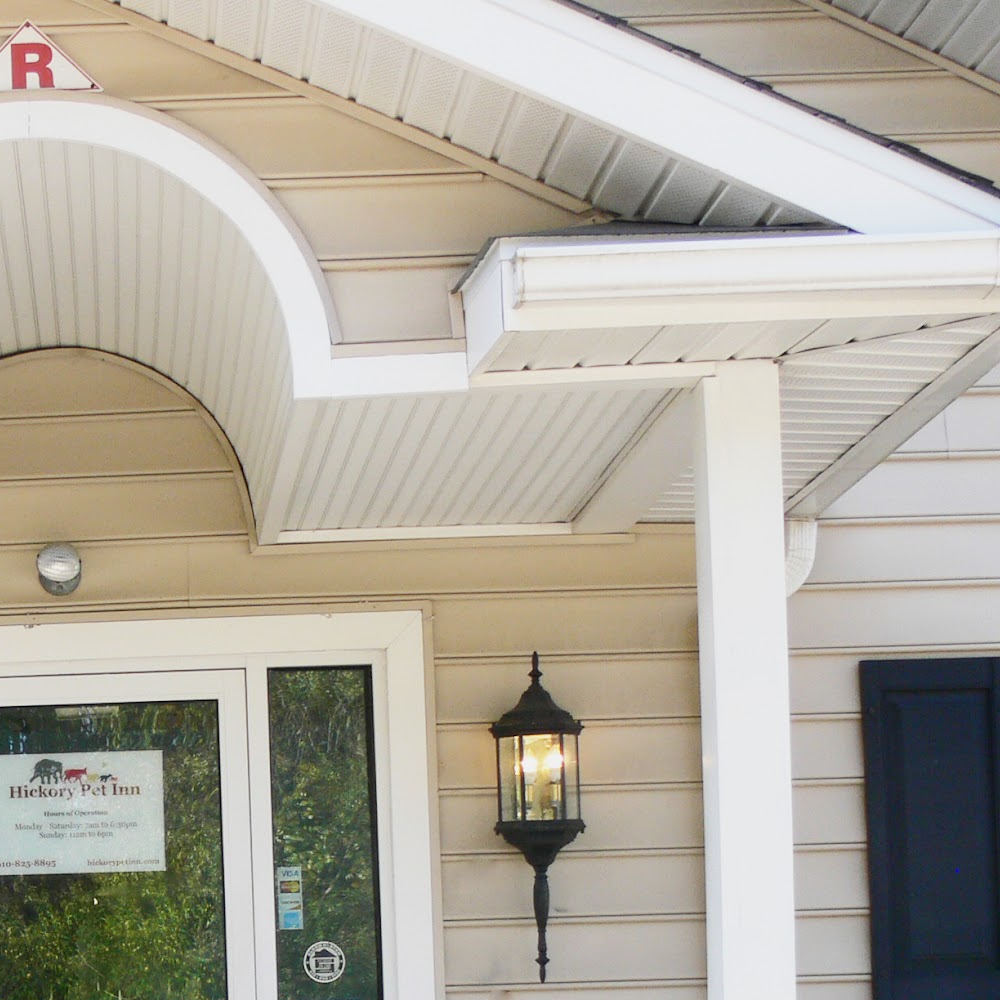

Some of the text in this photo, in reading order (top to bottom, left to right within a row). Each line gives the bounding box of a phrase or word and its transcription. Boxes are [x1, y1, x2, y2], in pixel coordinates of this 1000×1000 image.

[11, 43, 55, 89] R
[10, 783, 141, 800] Hickory Pet Inn
[74, 810, 108, 818] Operation
[15, 823, 43, 831] Monday
[49, 822, 82, 830] Saturday:
